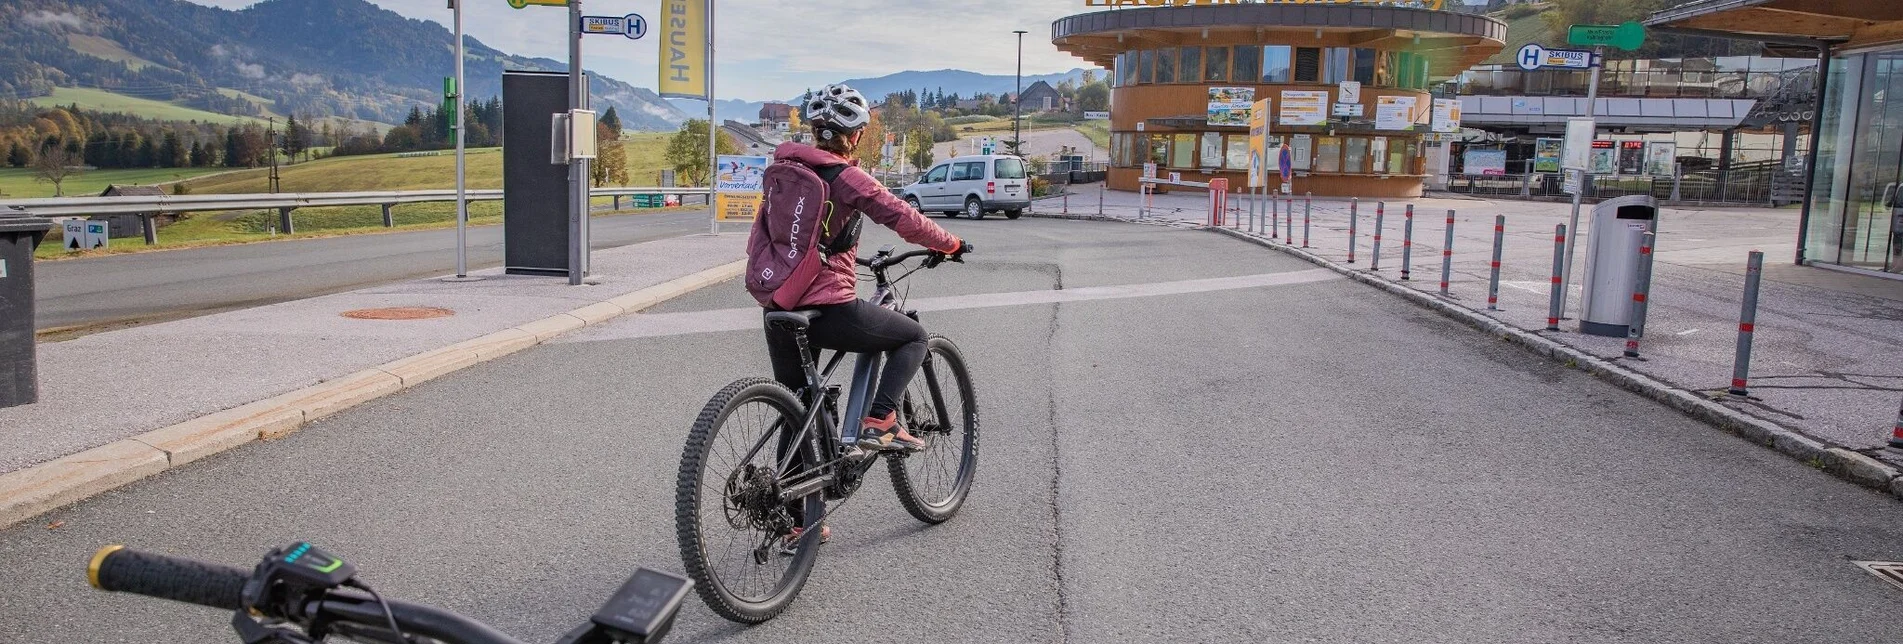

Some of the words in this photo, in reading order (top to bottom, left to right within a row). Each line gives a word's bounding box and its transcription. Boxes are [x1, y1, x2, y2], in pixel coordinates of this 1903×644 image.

[627, 18, 640, 34] H
[1523, 49, 1539, 66] H
[1549, 51, 1583, 60] SKIBUS
[719, 180, 759, 190] Vorverkauf
[788, 196, 806, 259] ORTOVOX
